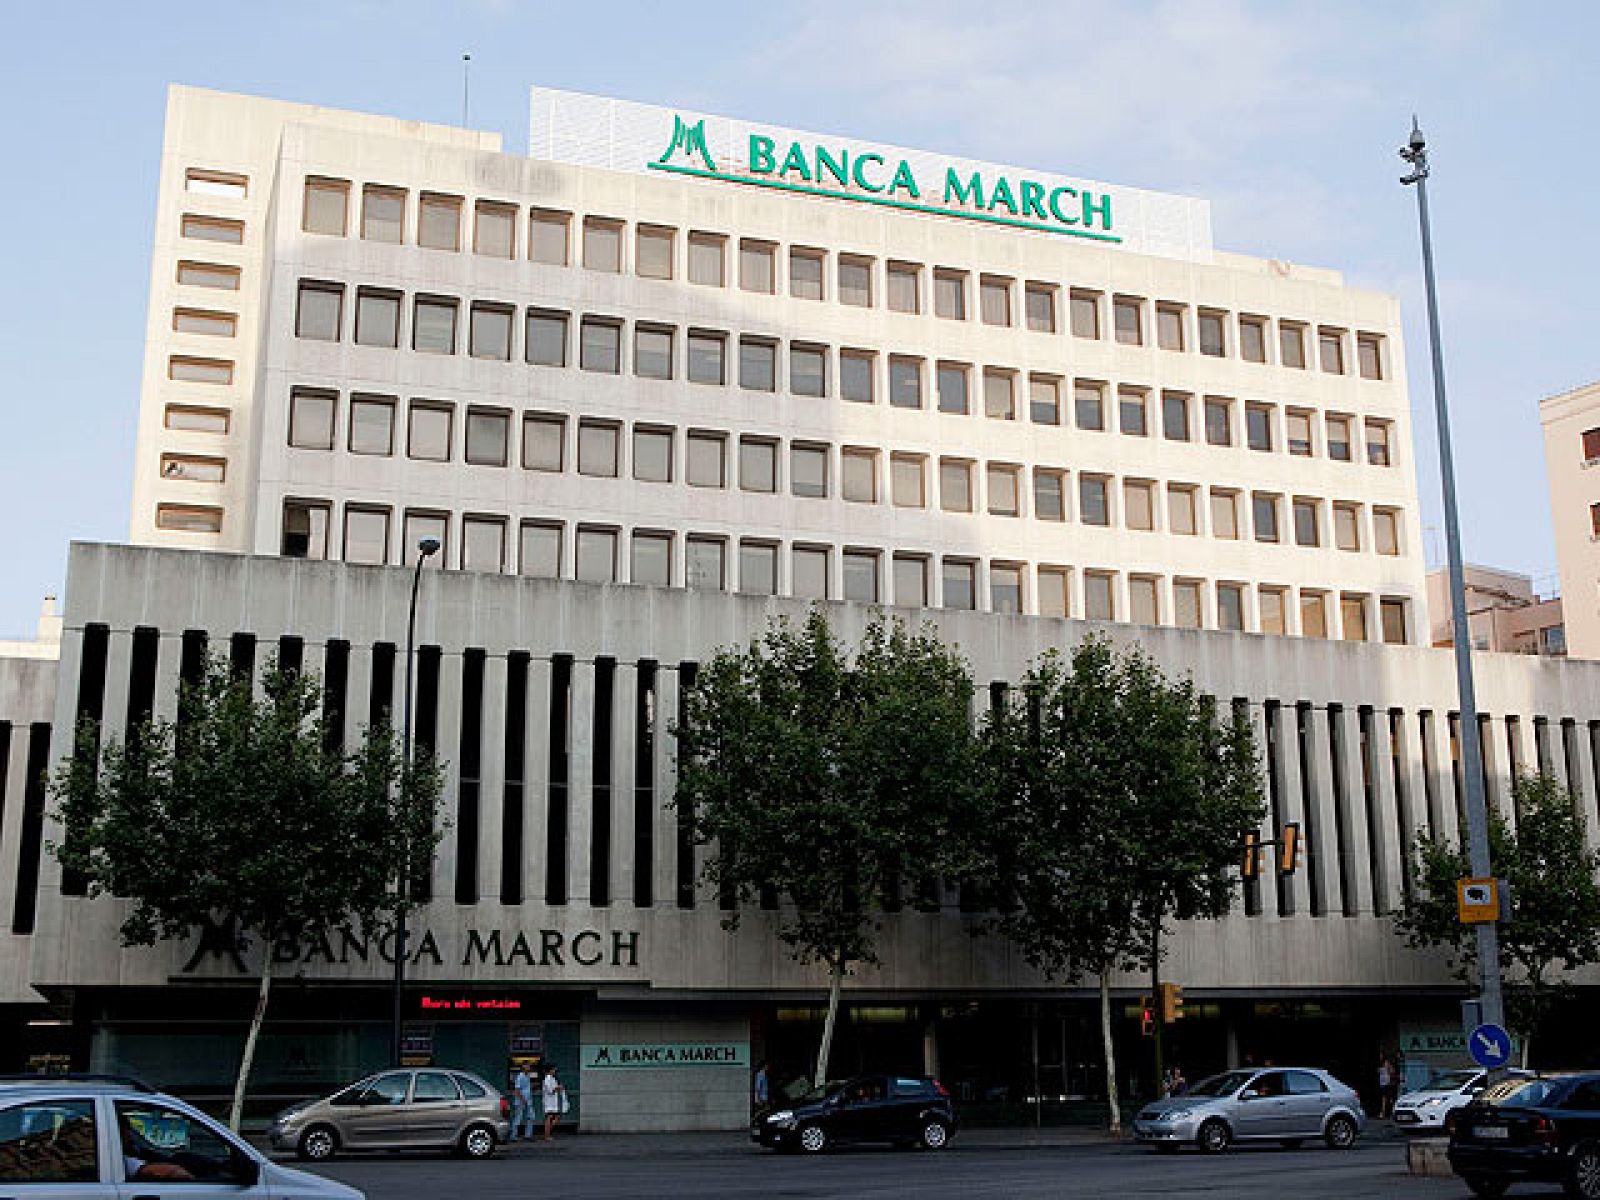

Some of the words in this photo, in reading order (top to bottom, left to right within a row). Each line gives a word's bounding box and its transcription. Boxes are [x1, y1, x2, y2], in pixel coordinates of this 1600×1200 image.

[749, 133, 920, 197] BANCA
[943, 165, 1112, 230] MARCH
[274, 925, 442, 964] BANCA
[462, 929, 639, 965] MARCH
[619, 1047, 676, 1062] BANCA
[680, 1046, 735, 1061] MARCH
